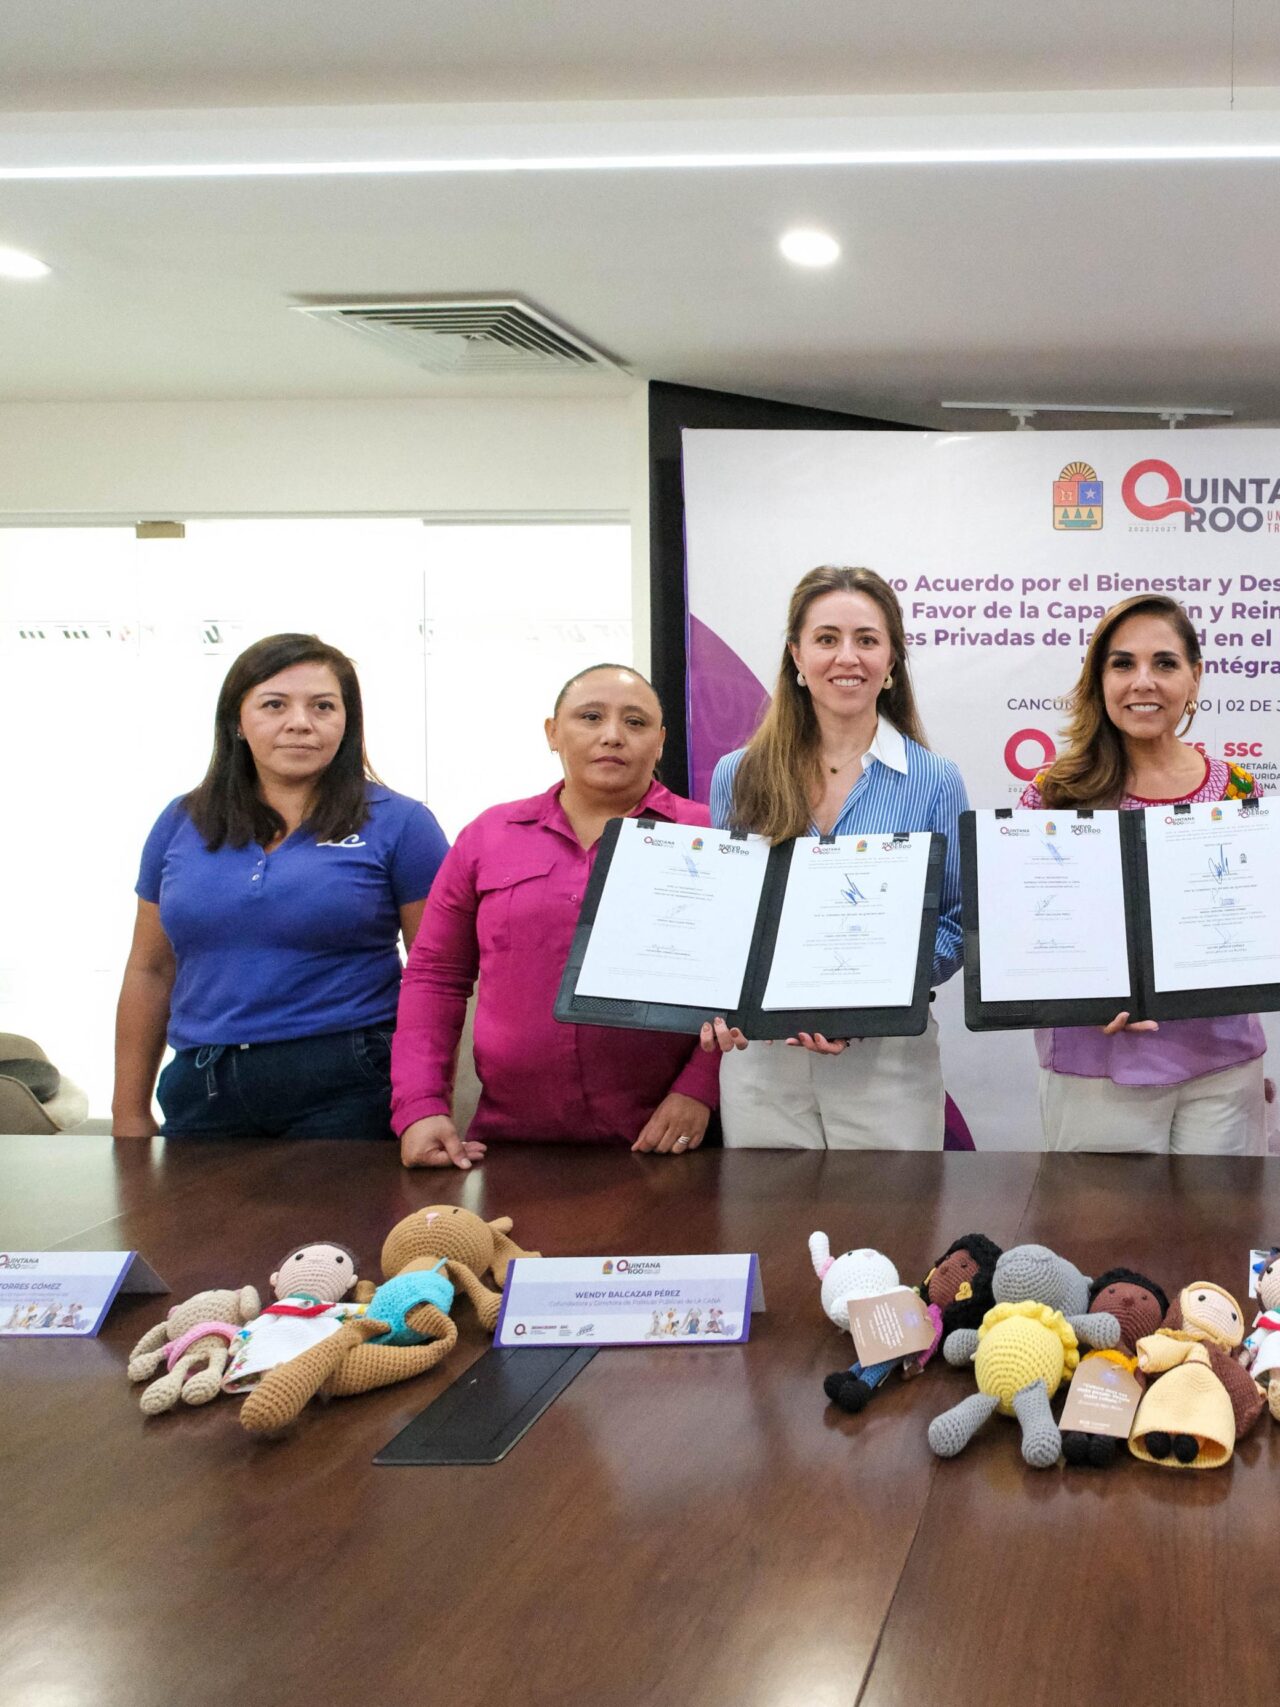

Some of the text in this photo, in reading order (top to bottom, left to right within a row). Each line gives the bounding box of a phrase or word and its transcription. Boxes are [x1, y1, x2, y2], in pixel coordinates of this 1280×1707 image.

[1184, 506, 1264, 533] ROO
[914, 574, 1015, 592] Acuerdo
[1022, 577, 1061, 596] por
[1068, 574, 1089, 592] el
[1097, 572, 1212, 592] Bienestar
[1218, 577, 1233, 596] y
[912, 602, 976, 619] Favor
[983, 601, 1013, 619] de
[1020, 601, 1040, 619] la
[1209, 605, 1224, 624] y
[934, 627, 1035, 646] Privadas
[1042, 628, 1072, 646] de
[1214, 632, 1244, 647] en
[1251, 628, 1272, 647] el
[1226, 699, 1245, 712] 02
[1250, 700, 1272, 712] DE
[1224, 742, 1263, 757] SSC
[575, 1287, 681, 1299] WENDY BALCAZAR PÉREZ
